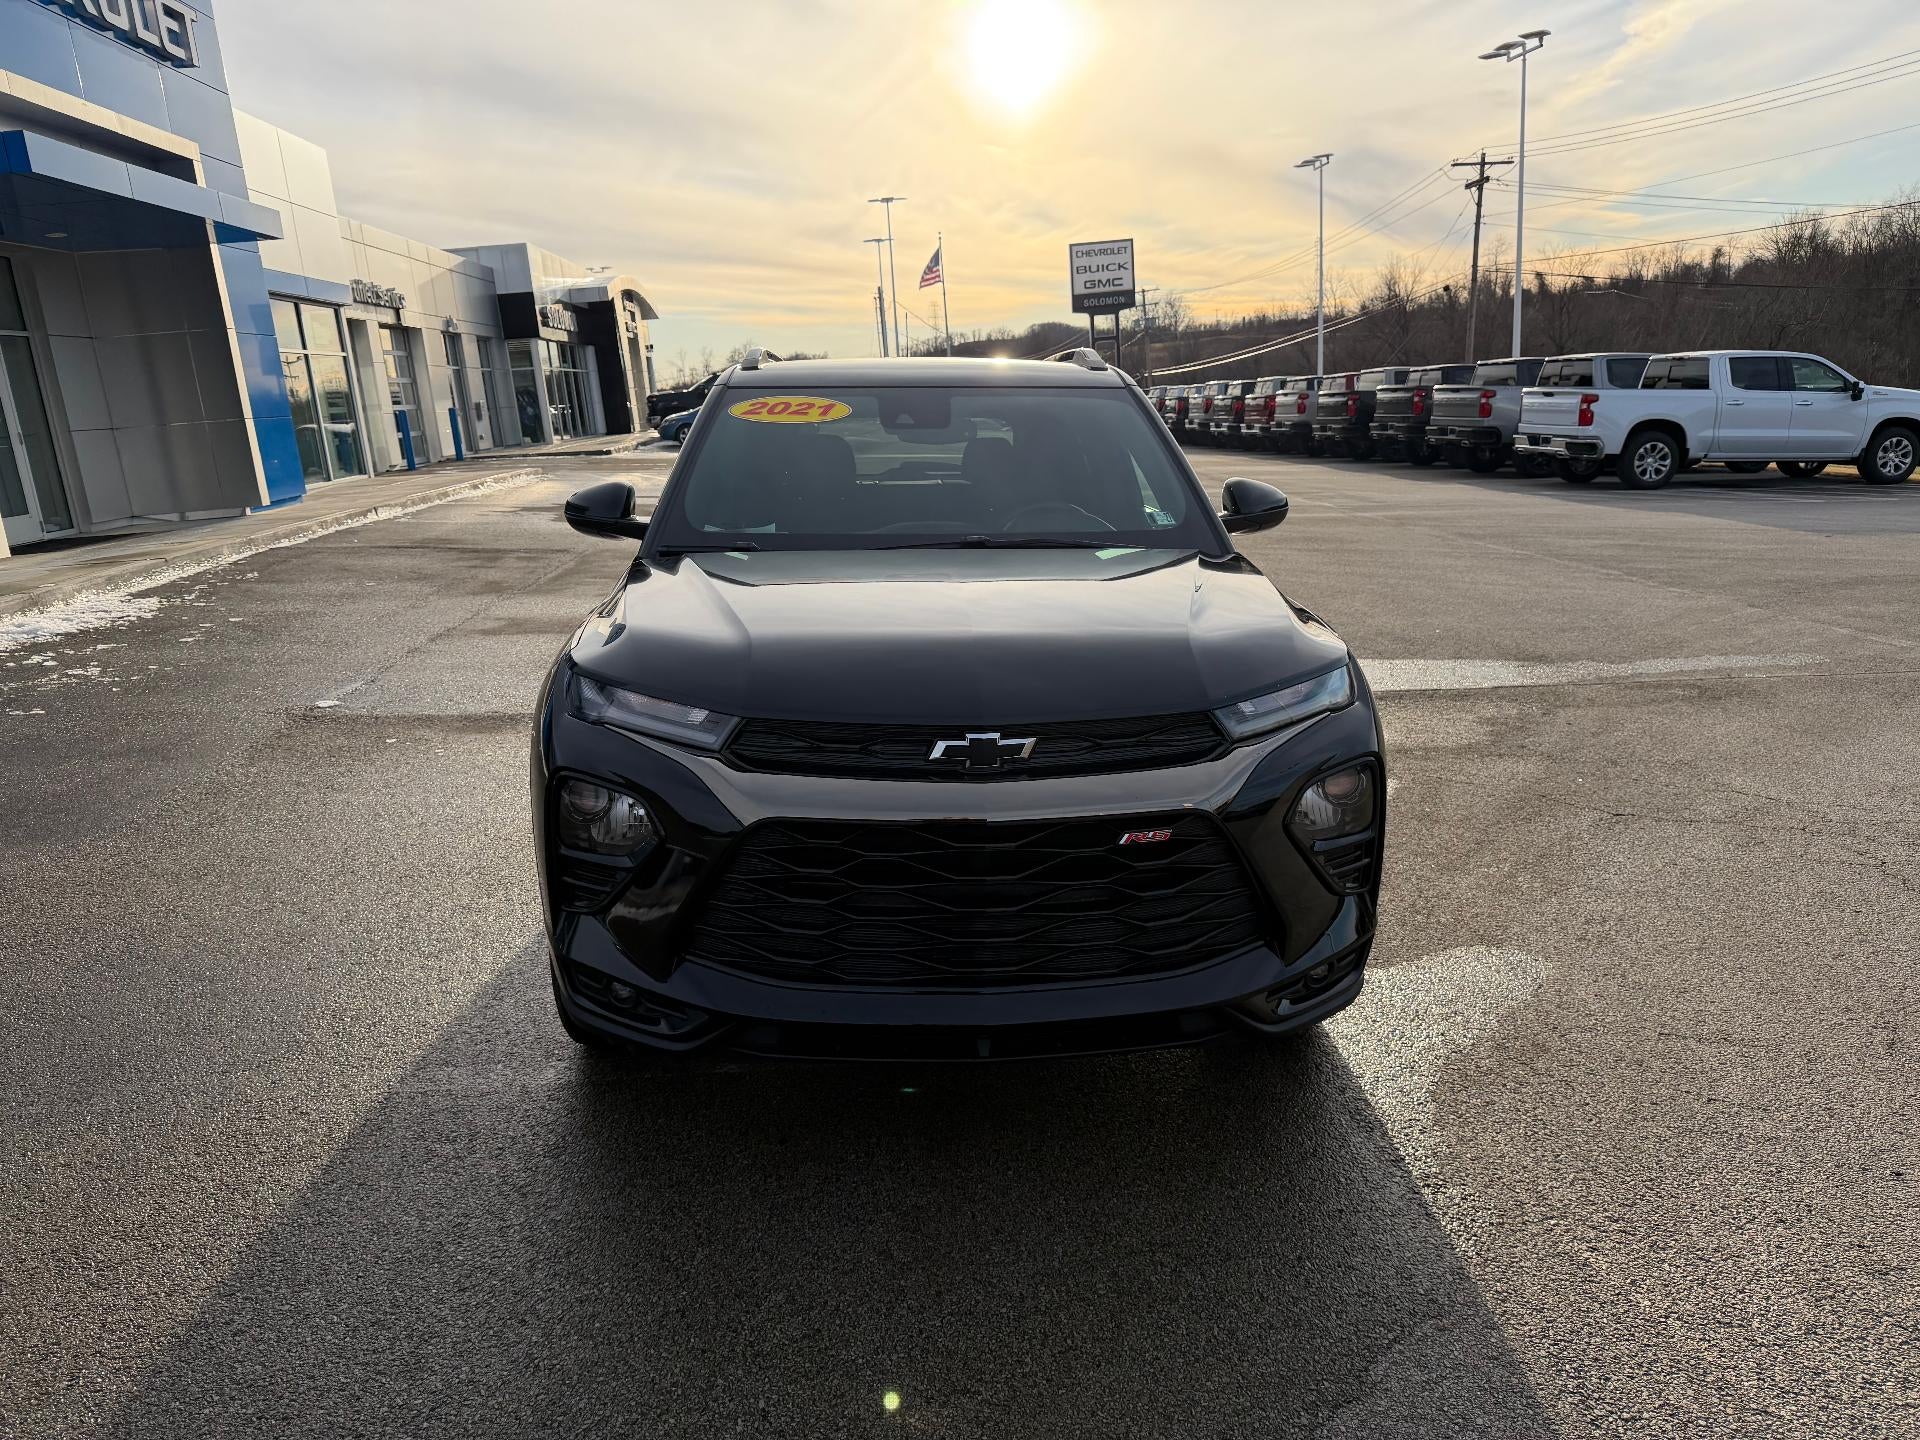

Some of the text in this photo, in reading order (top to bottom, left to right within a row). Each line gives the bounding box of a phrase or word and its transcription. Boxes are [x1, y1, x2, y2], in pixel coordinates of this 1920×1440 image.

[64, 0, 199, 67] OLET
[1075, 246, 1128, 258] CHEVROLET
[1076, 261, 1129, 275] BUICK
[1084, 277, 1123, 289] GMC
[1083, 295, 1125, 307] SOLOMON
[740, 401, 837, 417] 2021
[1119, 829, 1172, 845] RS
